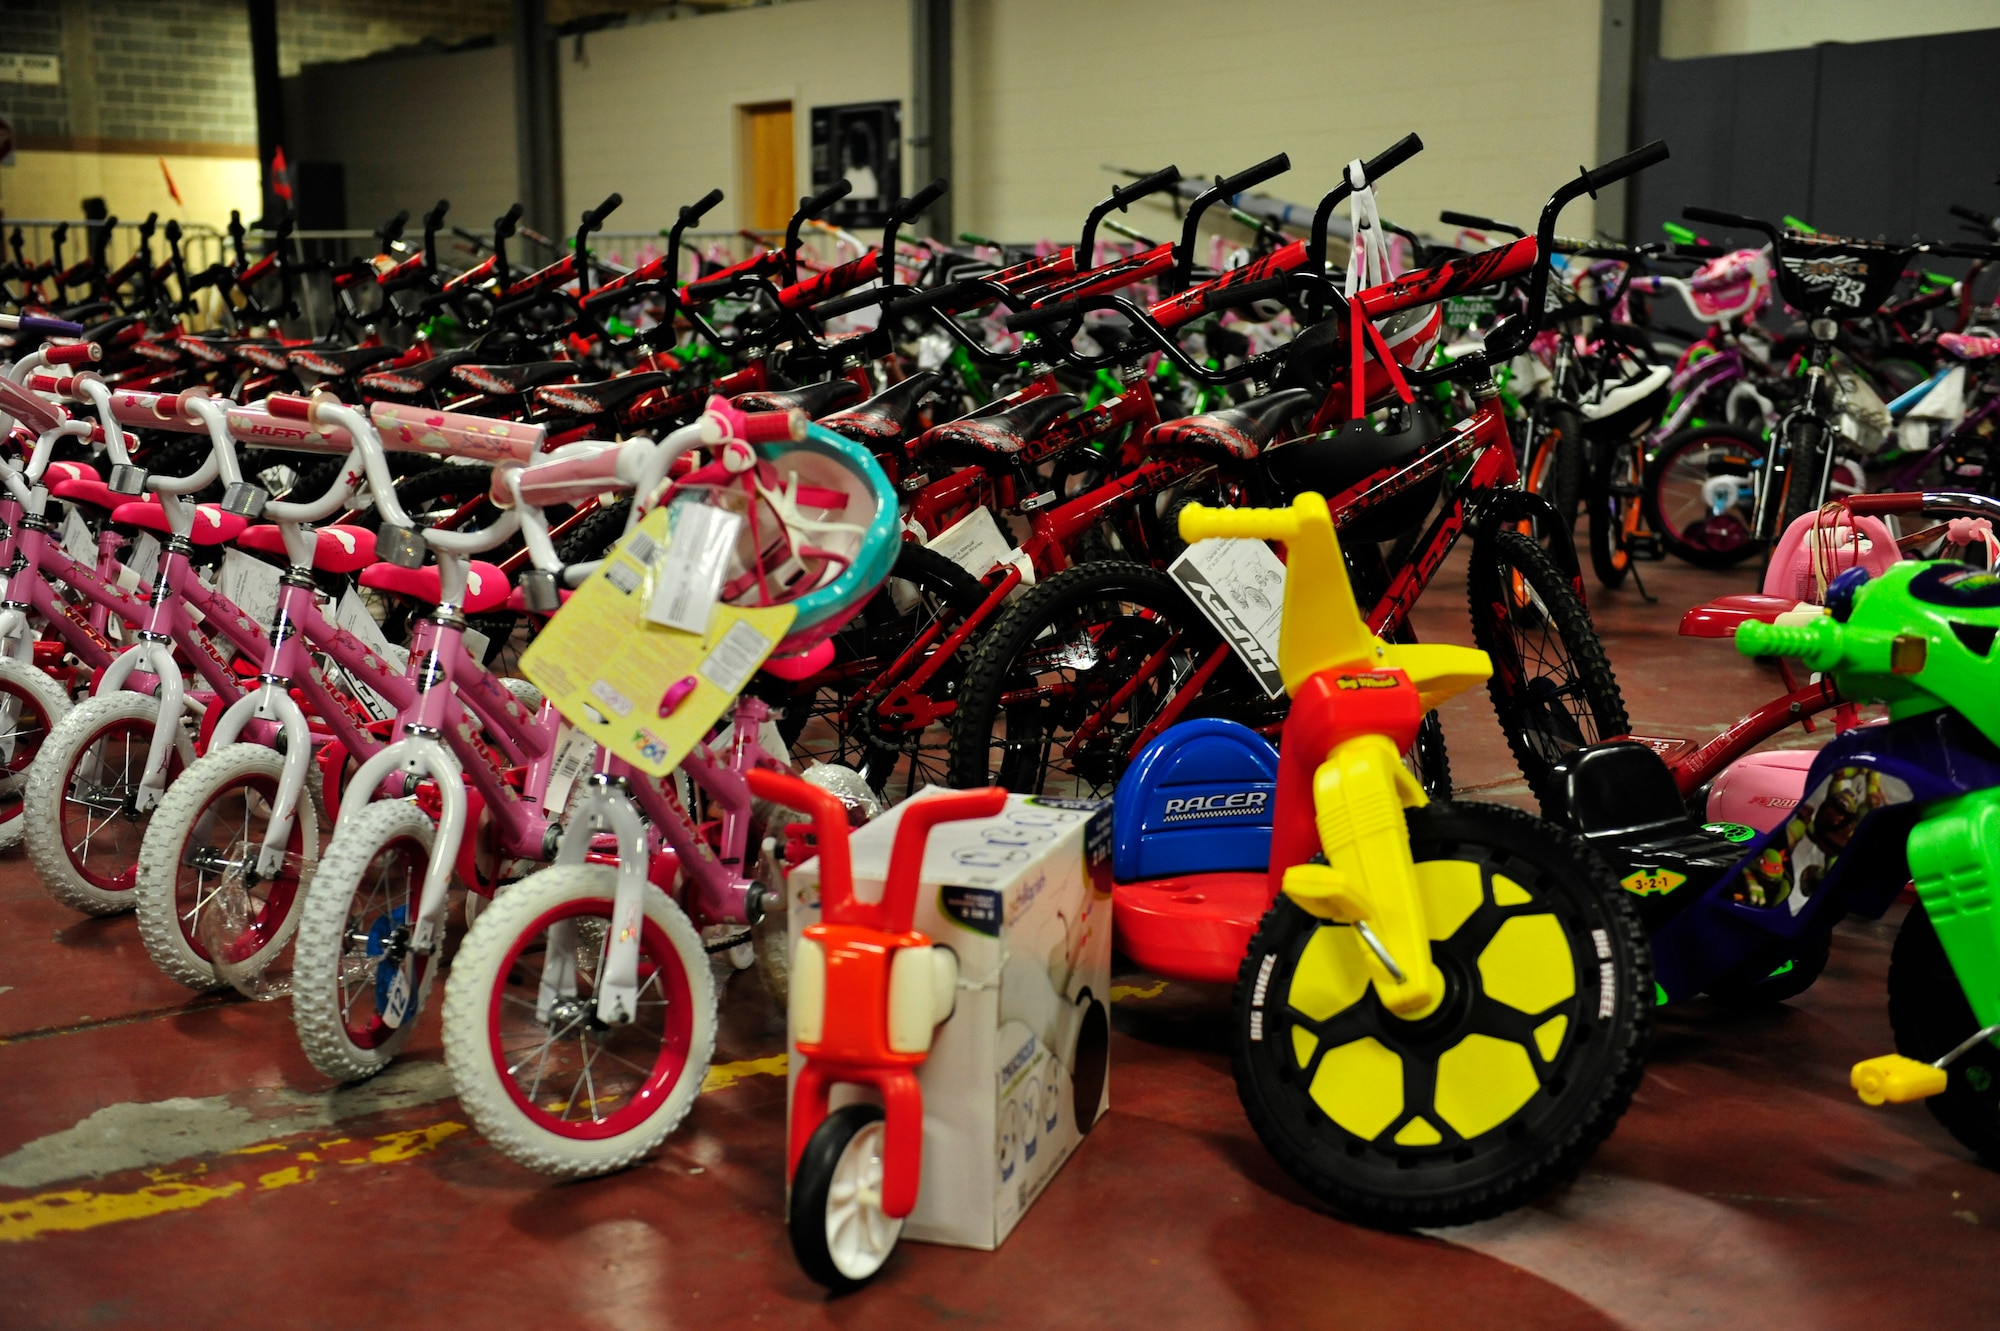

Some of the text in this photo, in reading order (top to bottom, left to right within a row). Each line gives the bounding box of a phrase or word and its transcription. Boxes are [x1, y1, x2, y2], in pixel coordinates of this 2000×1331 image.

[1832, 276, 1866, 307] 33
[251, 424, 308, 440] HUFFY
[1187, 580, 1279, 673] HUFFY
[200, 635, 244, 687] HUFFY
[1336, 678, 1359, 690] Big
[1357, 676, 1398, 688] Wheel
[321, 674, 364, 729] HUFFY
[1164, 791, 1268, 815] RACER
[1250, 954, 1277, 1040] BIG WHEEL
[1591, 929, 1616, 1020] BIG WHEEL
